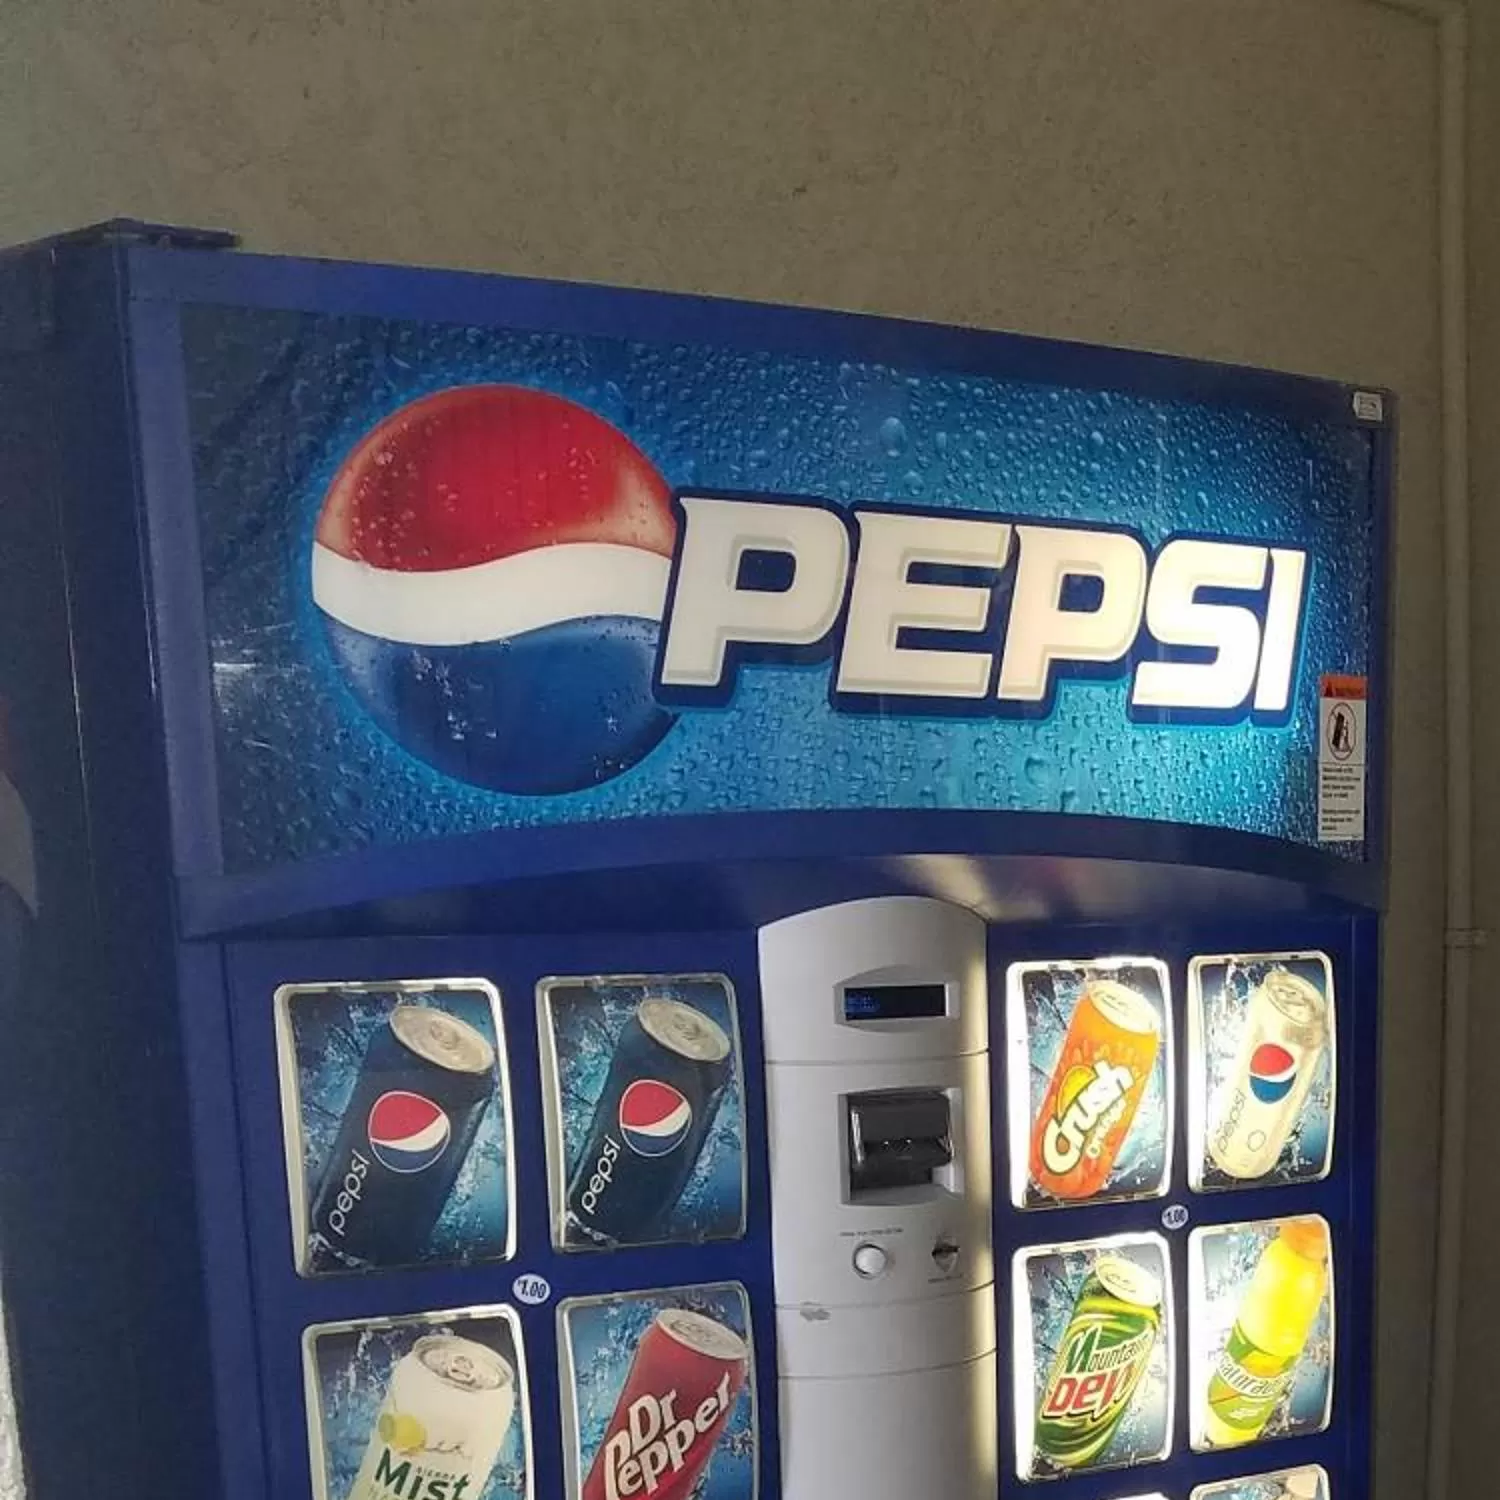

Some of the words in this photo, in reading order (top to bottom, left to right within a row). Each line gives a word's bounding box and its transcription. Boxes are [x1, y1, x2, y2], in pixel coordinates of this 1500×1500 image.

[658, 497, 1306, 711] PEPSI
[328, 1148, 371, 1238] pepsi
[580, 1135, 621, 1214] pepsi
[627, 1388, 679, 1453] Dr
